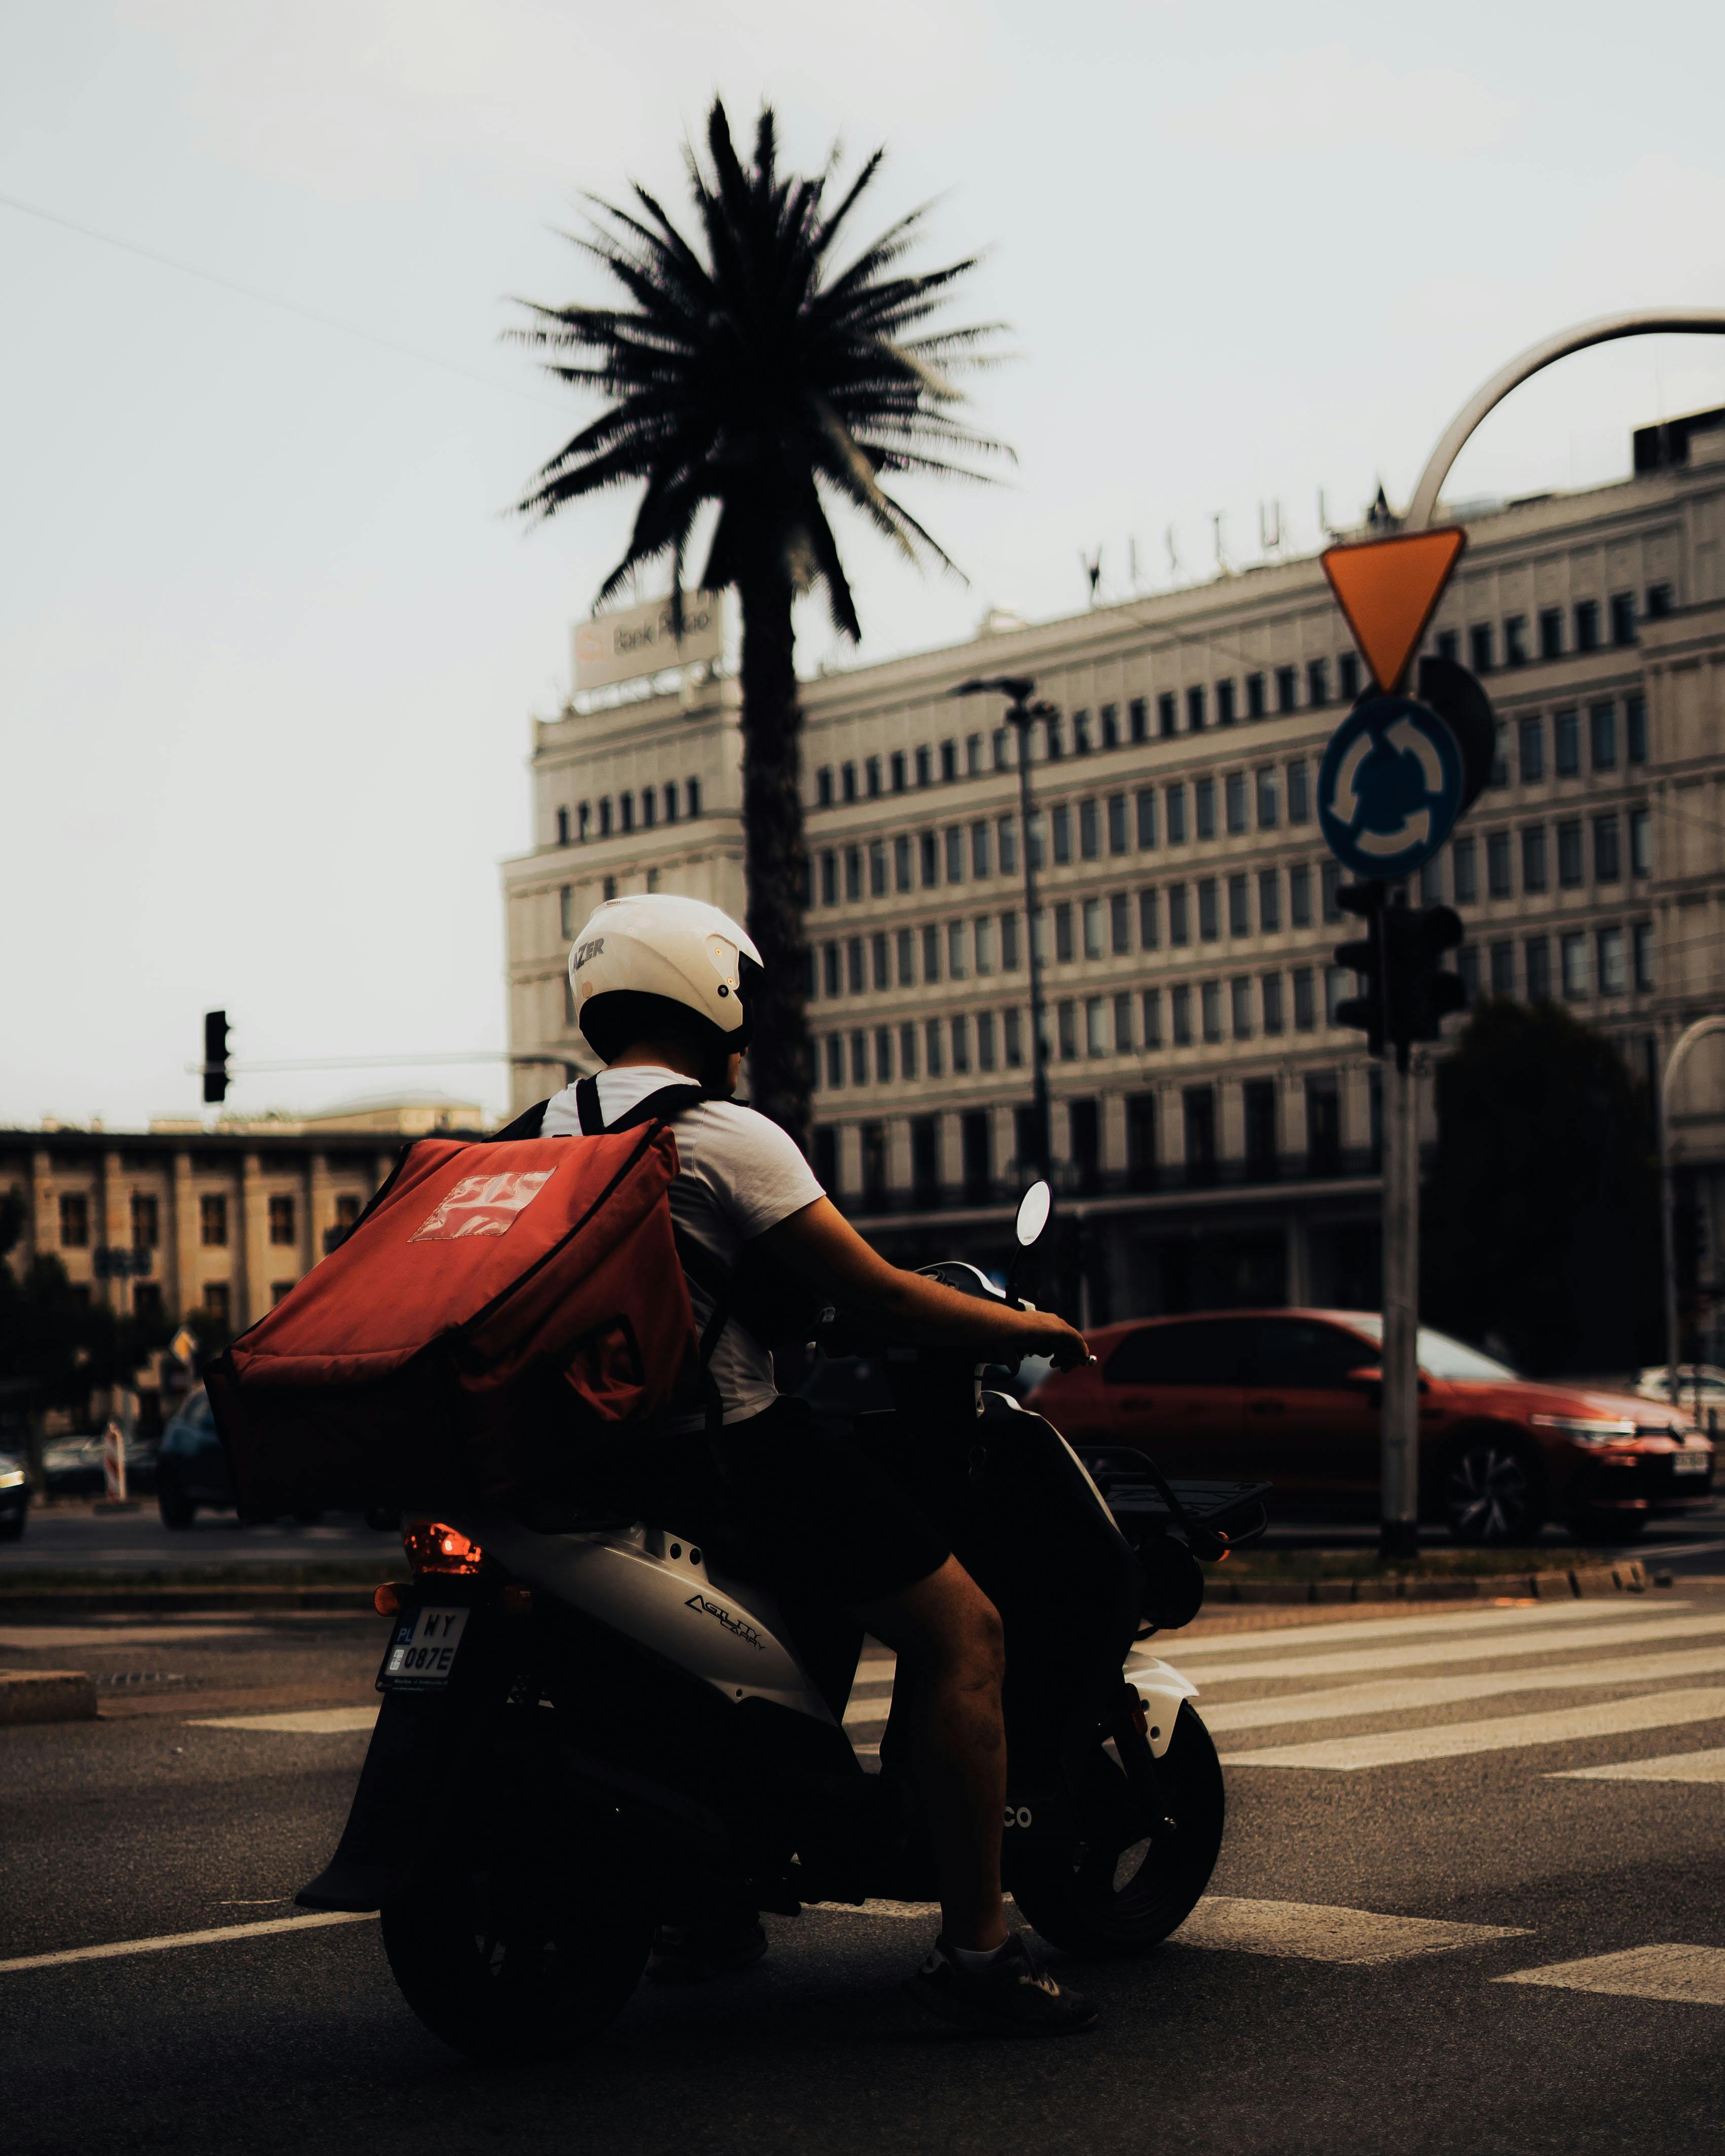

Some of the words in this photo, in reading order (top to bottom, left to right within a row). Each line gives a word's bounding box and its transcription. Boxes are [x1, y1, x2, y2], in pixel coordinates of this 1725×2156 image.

[424, 1614, 456, 1637] WY
[684, 1594, 762, 1639] AGILITY
[397, 1628, 411, 1642] PL
[719, 1619, 766, 1650] CARRY
[404, 1647, 454, 1670] 087E
